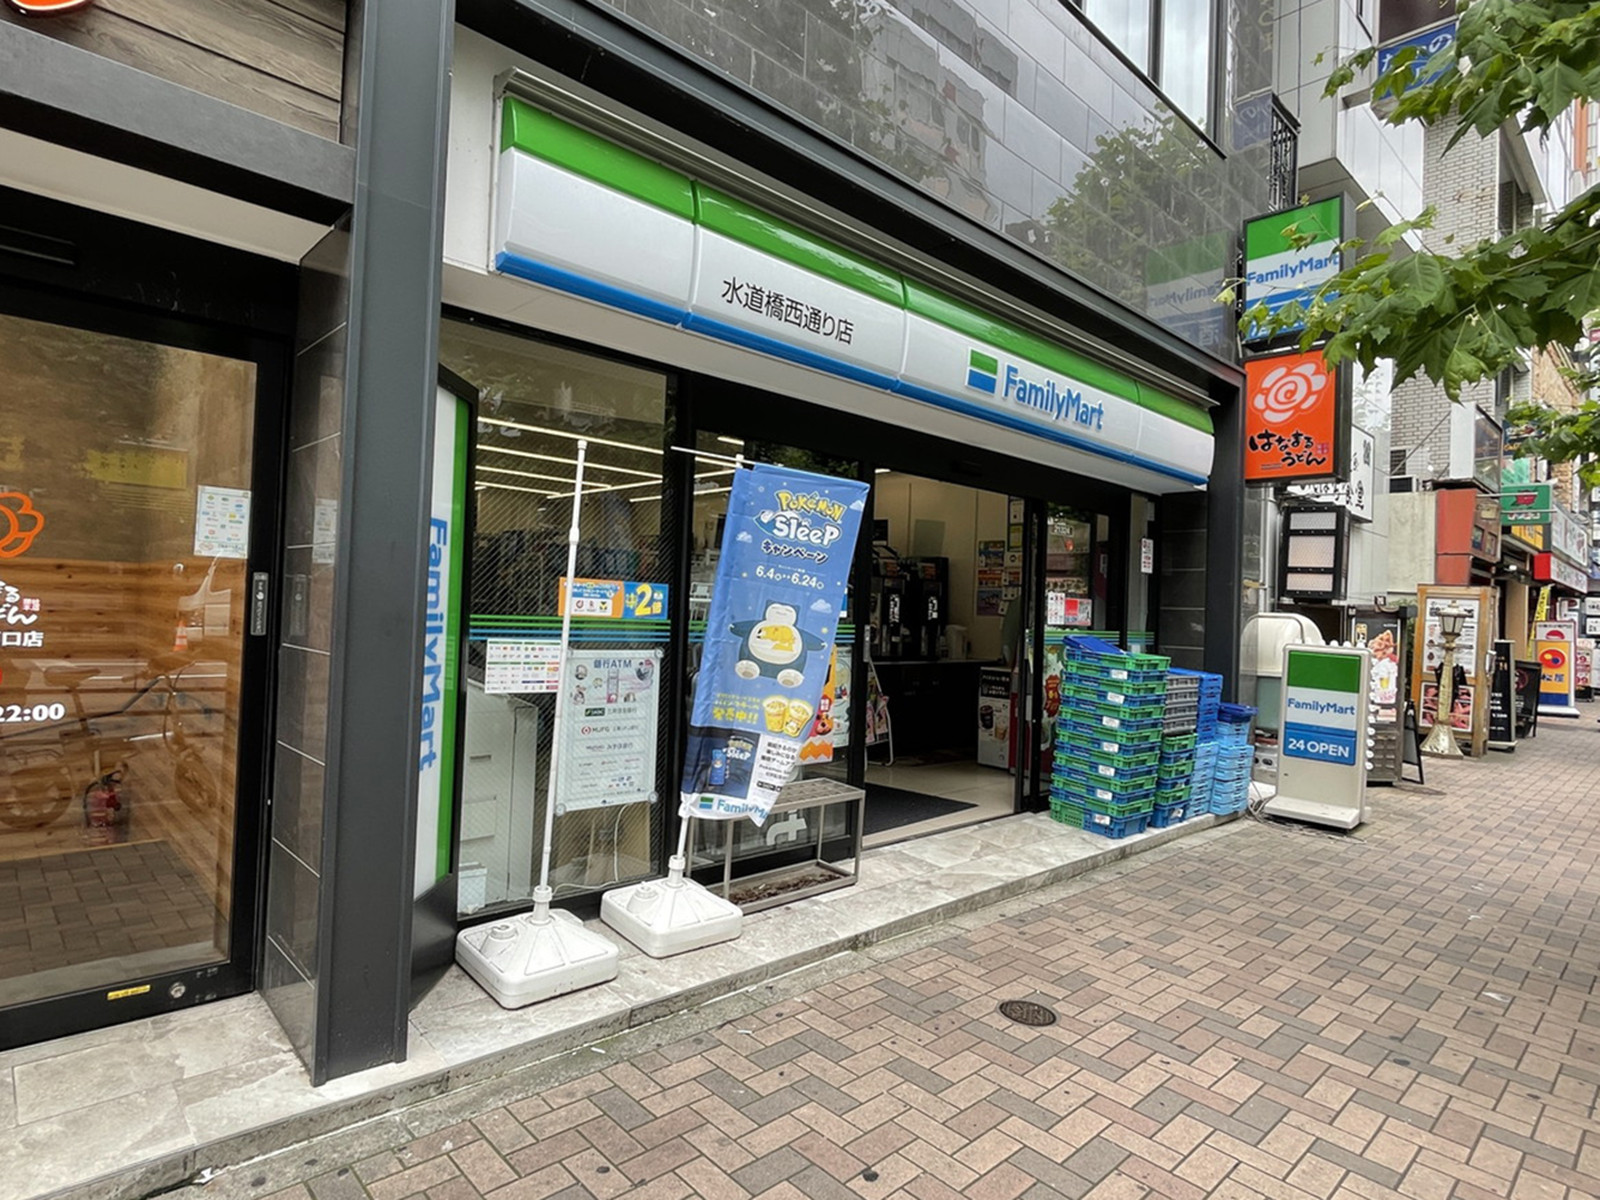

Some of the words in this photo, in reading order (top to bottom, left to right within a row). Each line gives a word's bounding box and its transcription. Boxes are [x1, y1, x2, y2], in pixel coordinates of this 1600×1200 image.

[1247, 254, 1339, 285] FamilyMart
[721, 276, 854, 345] 水道橋西通り店
[1003, 364, 1104, 429] FamilyMart
[1249, 429, 1313, 451] はなまる
[1281, 450, 1326, 467] うどん
[762, 540, 828, 564] キャンペーン
[0, 631, 44, 647] 口店
[418, 517, 447, 771] FamilyMart
[1287, 698, 1355, 715] FamilyMart
[1288, 738, 1305, 750] 24
[1307, 741, 1350, 758] OPEN
